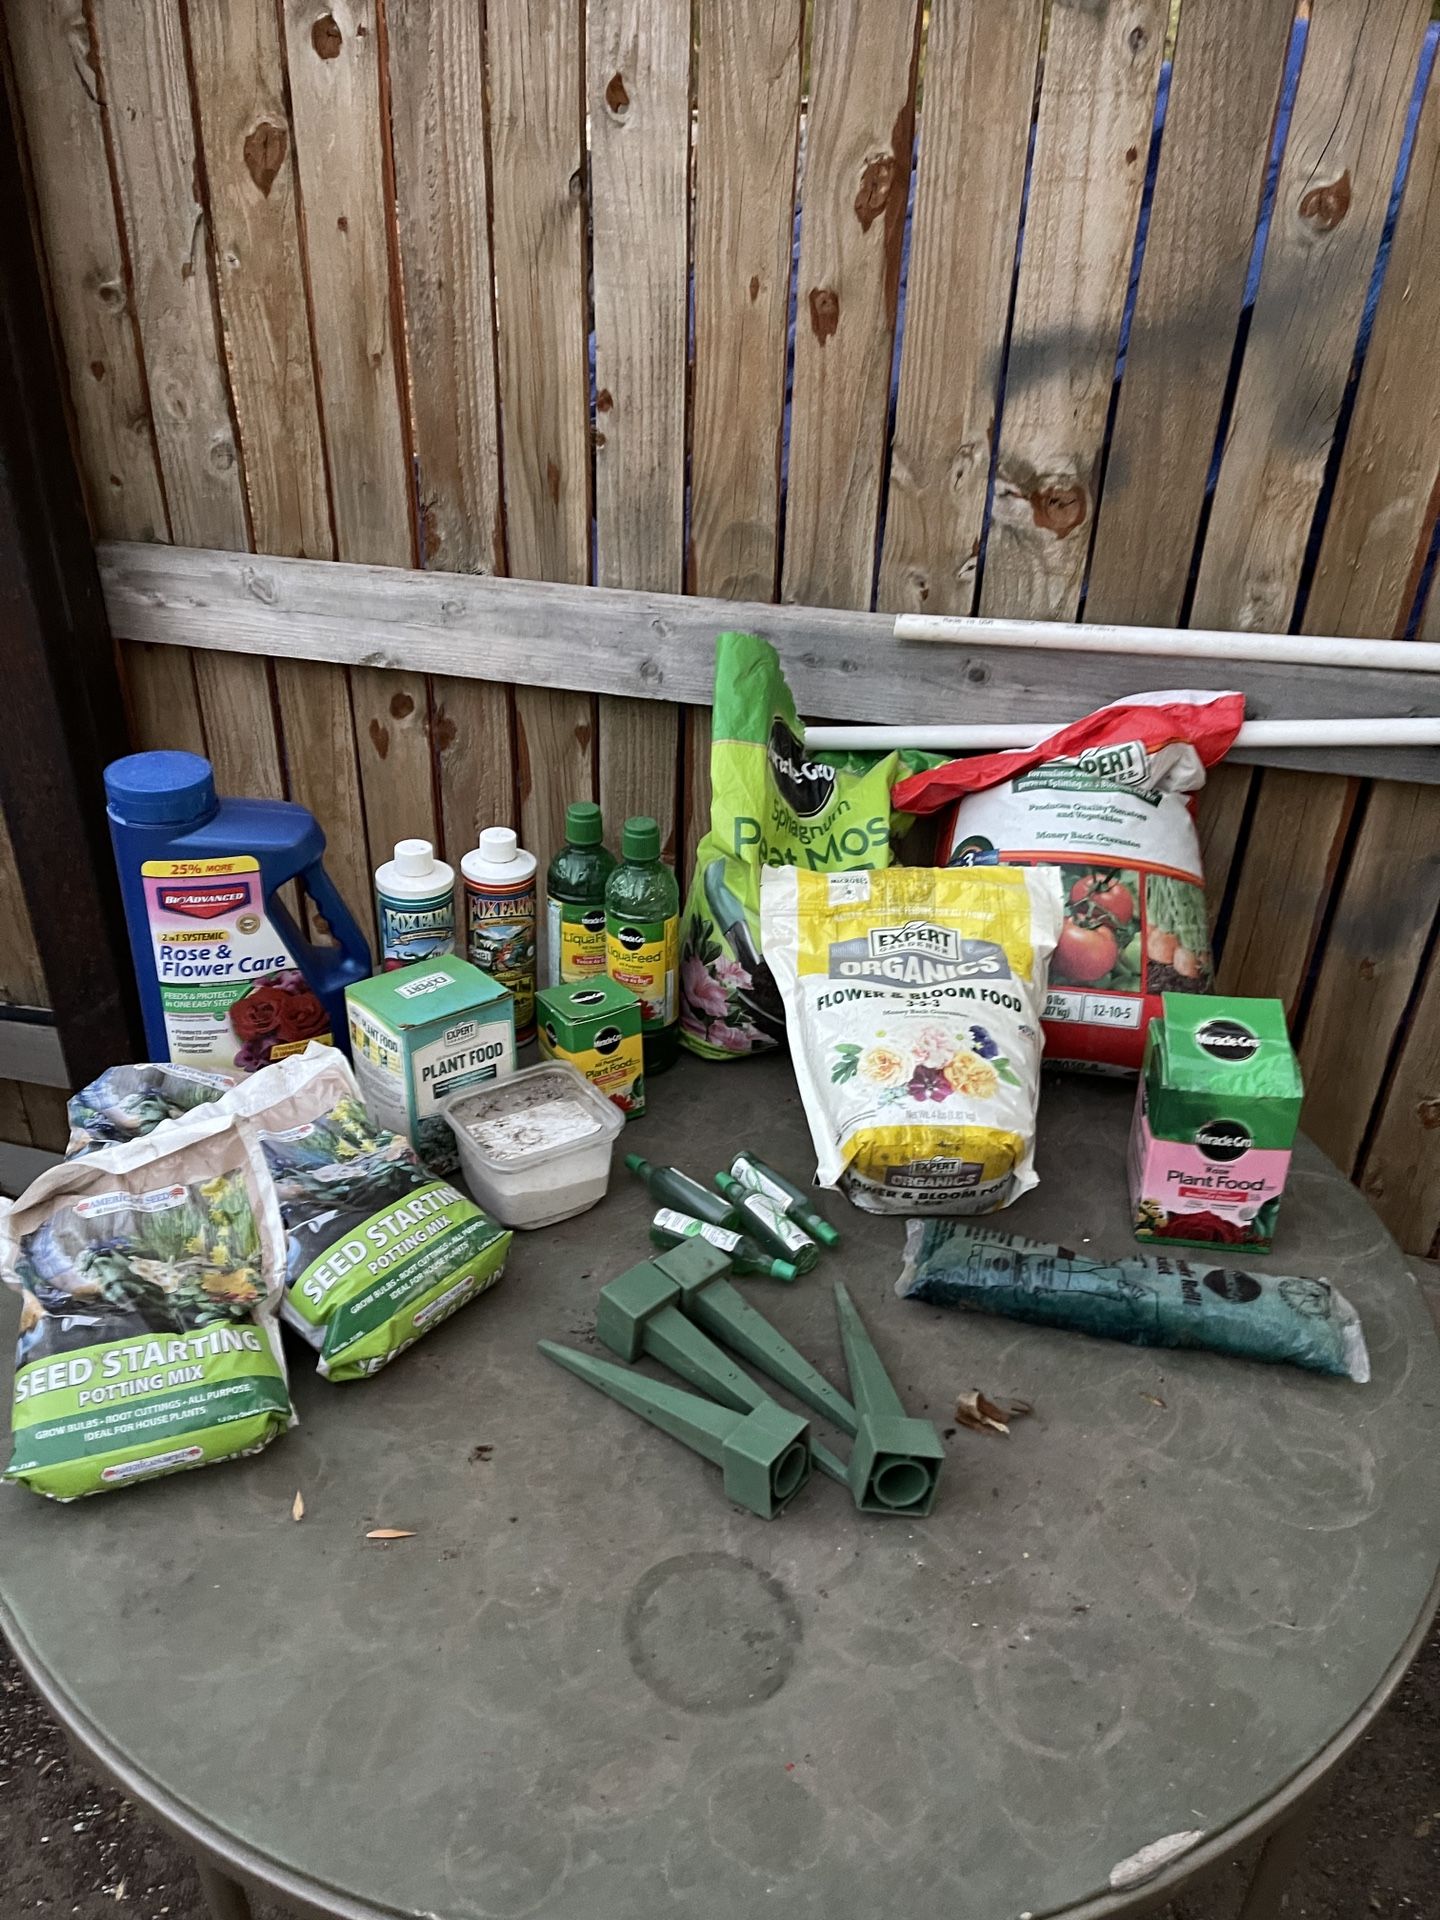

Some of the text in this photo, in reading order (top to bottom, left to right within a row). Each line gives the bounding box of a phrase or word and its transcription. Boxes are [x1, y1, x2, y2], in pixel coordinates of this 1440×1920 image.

[1083, 745, 1134, 775] PERT
[805, 816, 890, 871] MOS
[170, 863, 235, 875] 25% MORE
[182, 931, 224, 942] SYSTEMIC
[563, 931, 606, 946] LiquaFe
[879, 928, 951, 948] EXPERT
[160, 944, 232, 961] Rose &
[162, 955, 286, 977] Flower Care
[839, 955, 1001, 985] ORGANICS
[164, 991, 188, 1000] FEEDS
[197, 989, 238, 1000] PROTECTS
[405, 976, 448, 995] EXPERT
[192, 1000, 212, 1008] EASY
[816, 987, 886, 1011] FLOWER
[909, 986, 975, 1000] BLOOM
[981, 987, 1022, 1013] FOOD
[906, 999, 940, 1007] 3-5-3
[1093, 1004, 1132, 1019] 12-10-5
[380, 1031, 399, 1053] FOOD
[446, 1023, 475, 1042] EXPERT
[422, 1053, 466, 1082] PLANT
[470, 1042, 503, 1066] FOOD
[585, 1065, 609, 1080] Plant
[610, 1058, 632, 1072] Food
[915, 1160, 957, 1172] EXPERT
[891, 1174, 977, 1188] ORGANICS
[1166, 1170, 1265, 1191] Plant Food
[918, 1187, 976, 1200] BLOOM
[303, 1240, 368, 1305] SEED
[365, 1186, 468, 1248] STARTIN
[367, 1215, 453, 1275] POTTING MIX
[350, 1294, 374, 1314] GROW
[372, 1280, 397, 1298] BULBS
[399, 1264, 419, 1281] ROOT
[417, 1243, 450, 1271] CUTTINGS
[389, 1284, 412, 1300] IDEAL
[409, 1273, 424, 1287] FOR
[15, 1327, 263, 1404] SEED STARTING
[77, 1364, 206, 1408] POTTING MIX
[35, 1383, 251, 1441] GROW BULBS ROOT CUTTINGS ALL PURPOSE
[84, 1406, 207, 1442] IDEAL FOR HOUSE PLANTS
